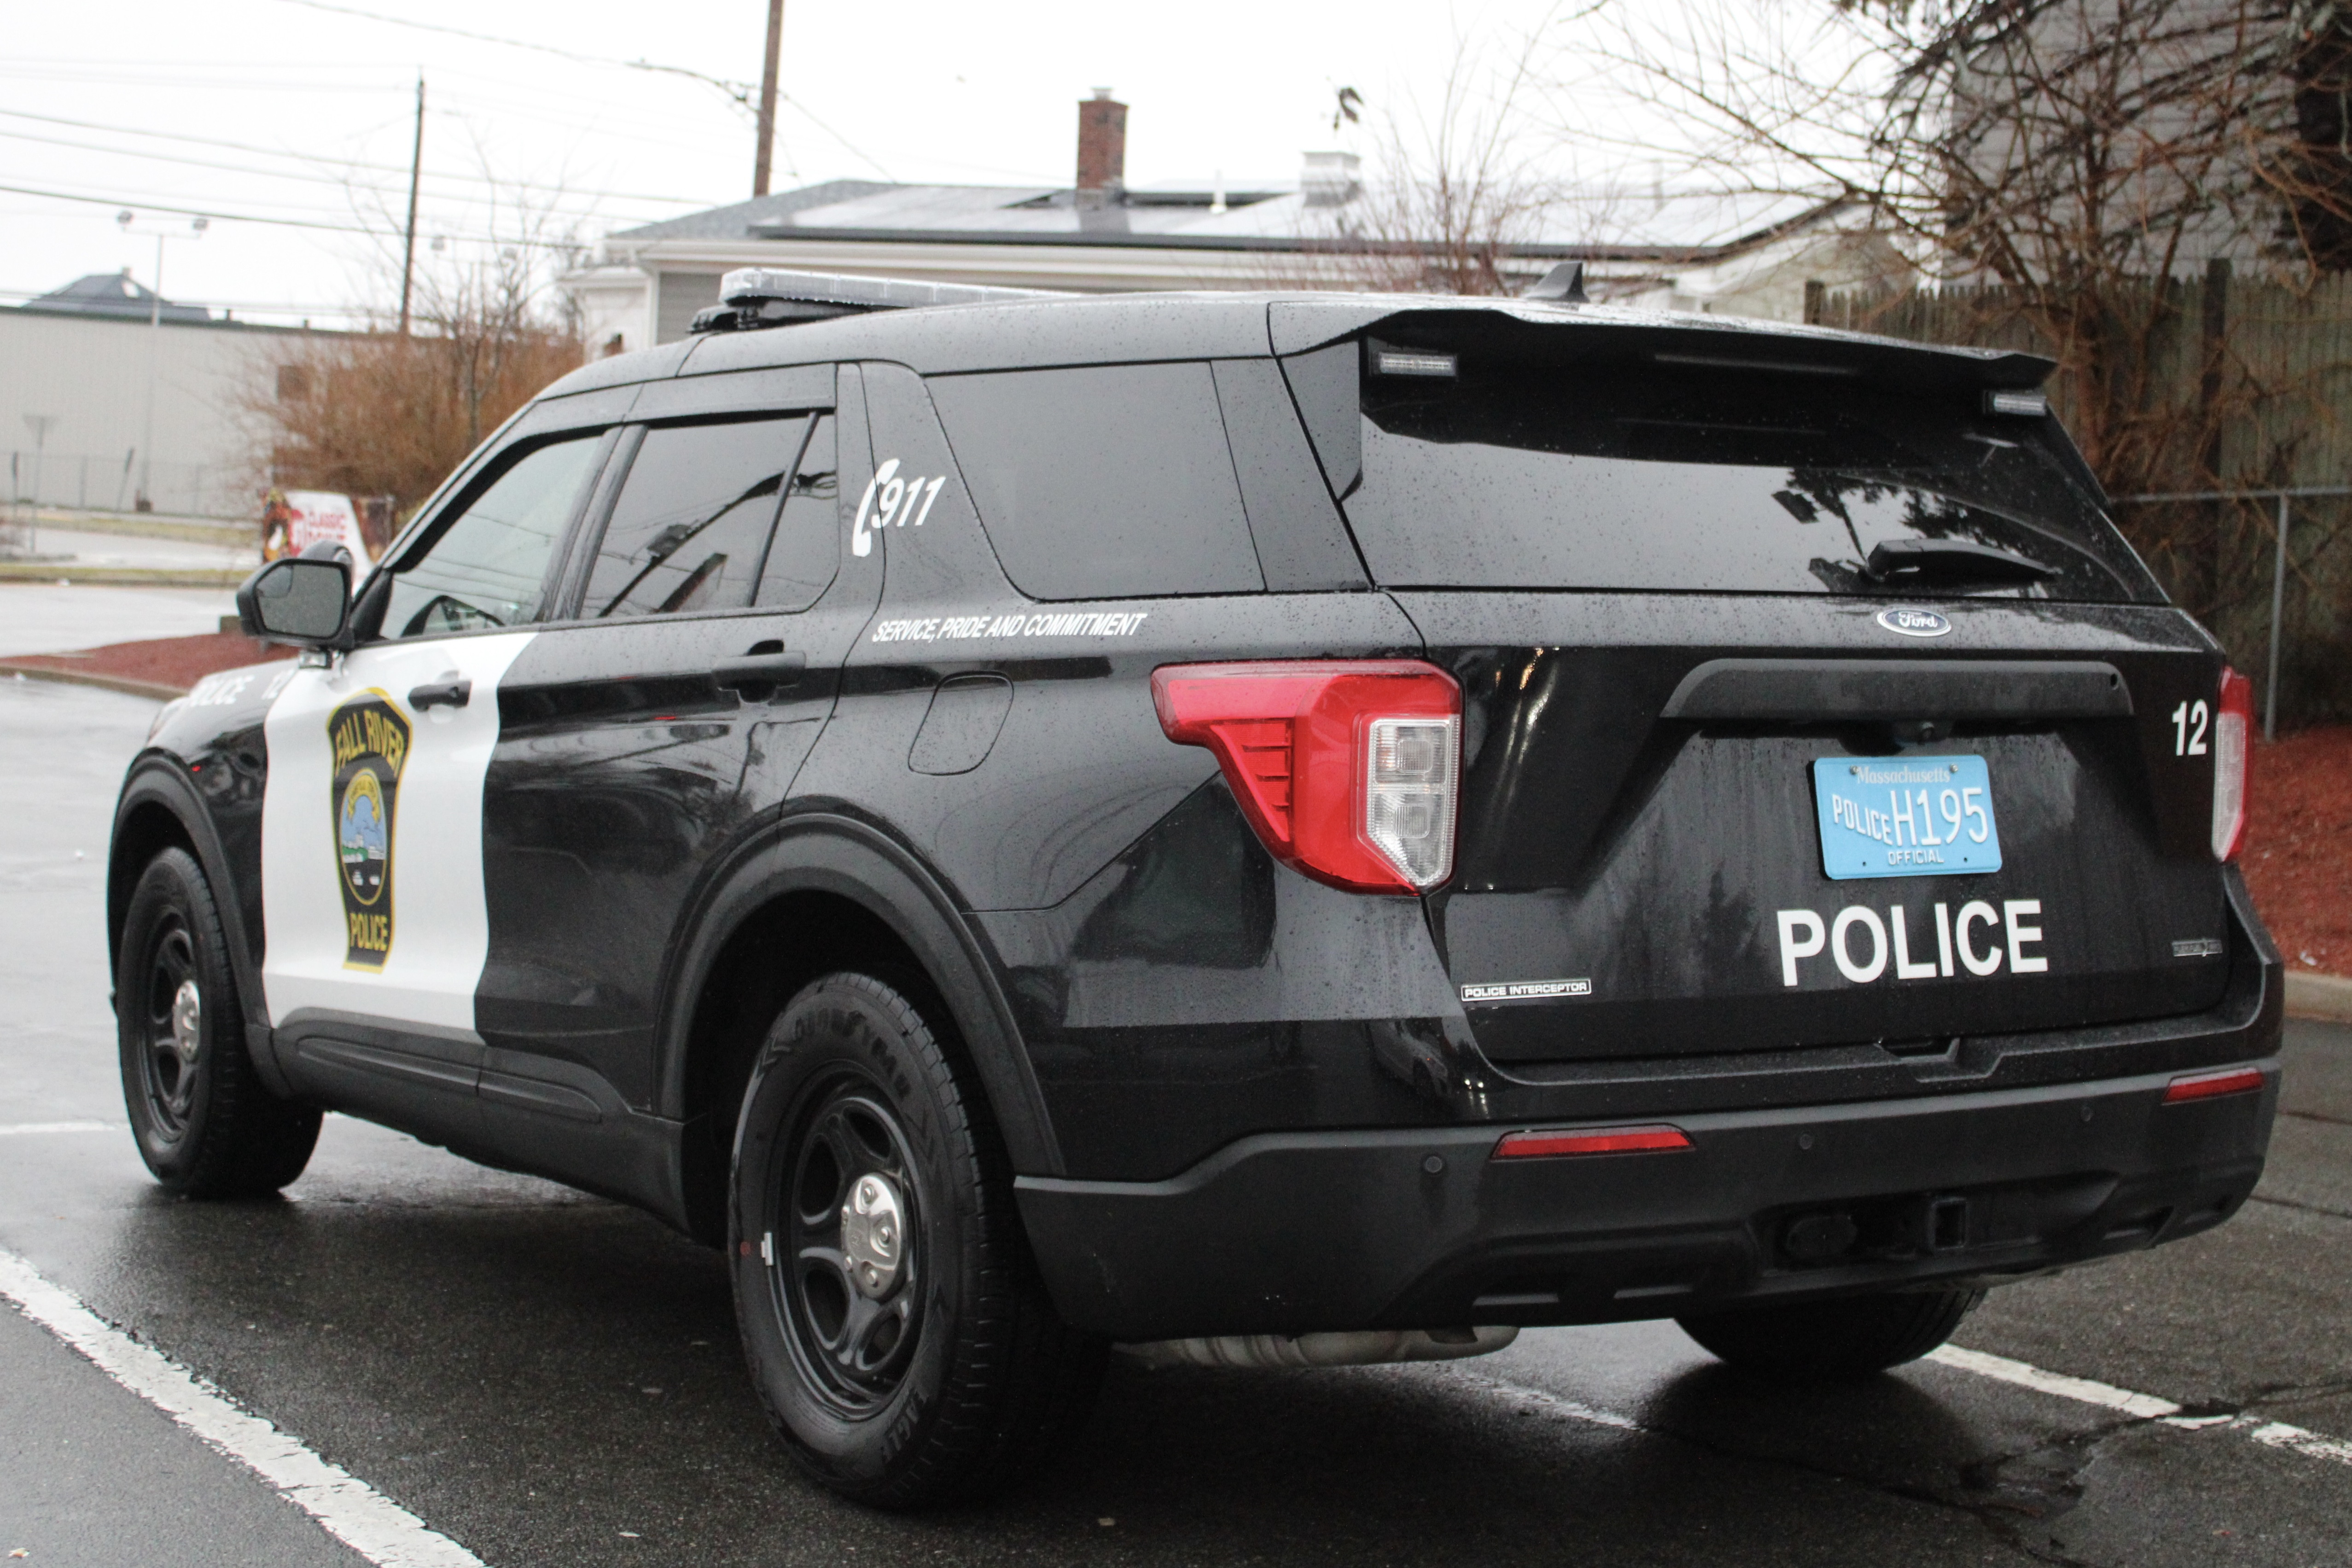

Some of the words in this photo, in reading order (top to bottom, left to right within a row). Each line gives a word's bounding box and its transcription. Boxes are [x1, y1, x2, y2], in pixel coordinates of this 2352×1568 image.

[871, 476, 946, 529] 911
[872, 618, 942, 643] SERVICE,
[936, 616, 992, 640] PRIDE
[984, 615, 1027, 638] AND
[1024, 612, 1148, 637] COMMITMENT
[1898, 611, 1938, 628] Ford
[335, 712, 367, 778] FALL
[363, 709, 405, 778] RIVER
[2172, 699, 2209, 756] 12
[1857, 764, 1951, 785] Massachusetts
[1832, 793, 1893, 846] POLICE
[1890, 787, 1989, 847] H195
[1888, 848, 1945, 866] OFFICIAL
[349, 912, 388, 951] POLICE
[1777, 900, 2049, 987] POLICE
[1464, 986, 1507, 998] POLICE
[1509, 981, 1587, 995] INTERCEPTOR
